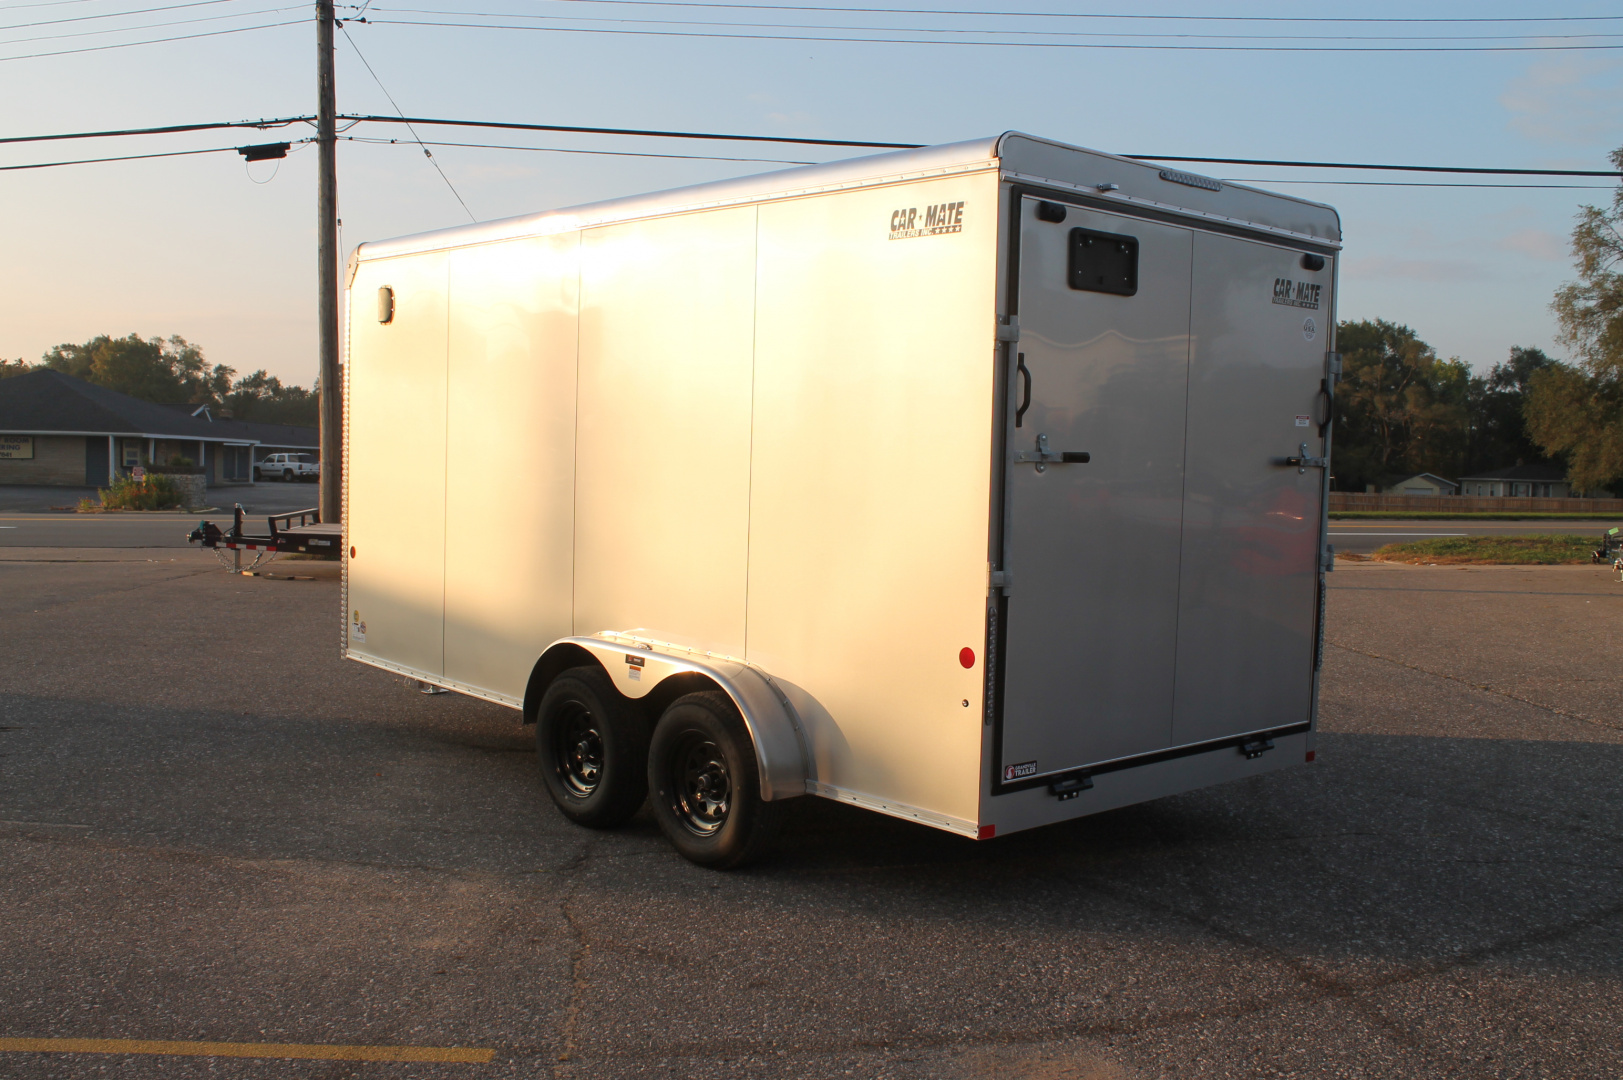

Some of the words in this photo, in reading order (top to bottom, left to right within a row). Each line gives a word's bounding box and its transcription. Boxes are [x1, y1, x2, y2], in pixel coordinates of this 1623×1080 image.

[891, 208, 917, 231] CAR
[925, 201, 964, 227] MATE
[1274, 278, 1291, 298] CAR
[1296, 282, 1320, 302] MATE
[1015, 767, 1036, 776] TRAILER
